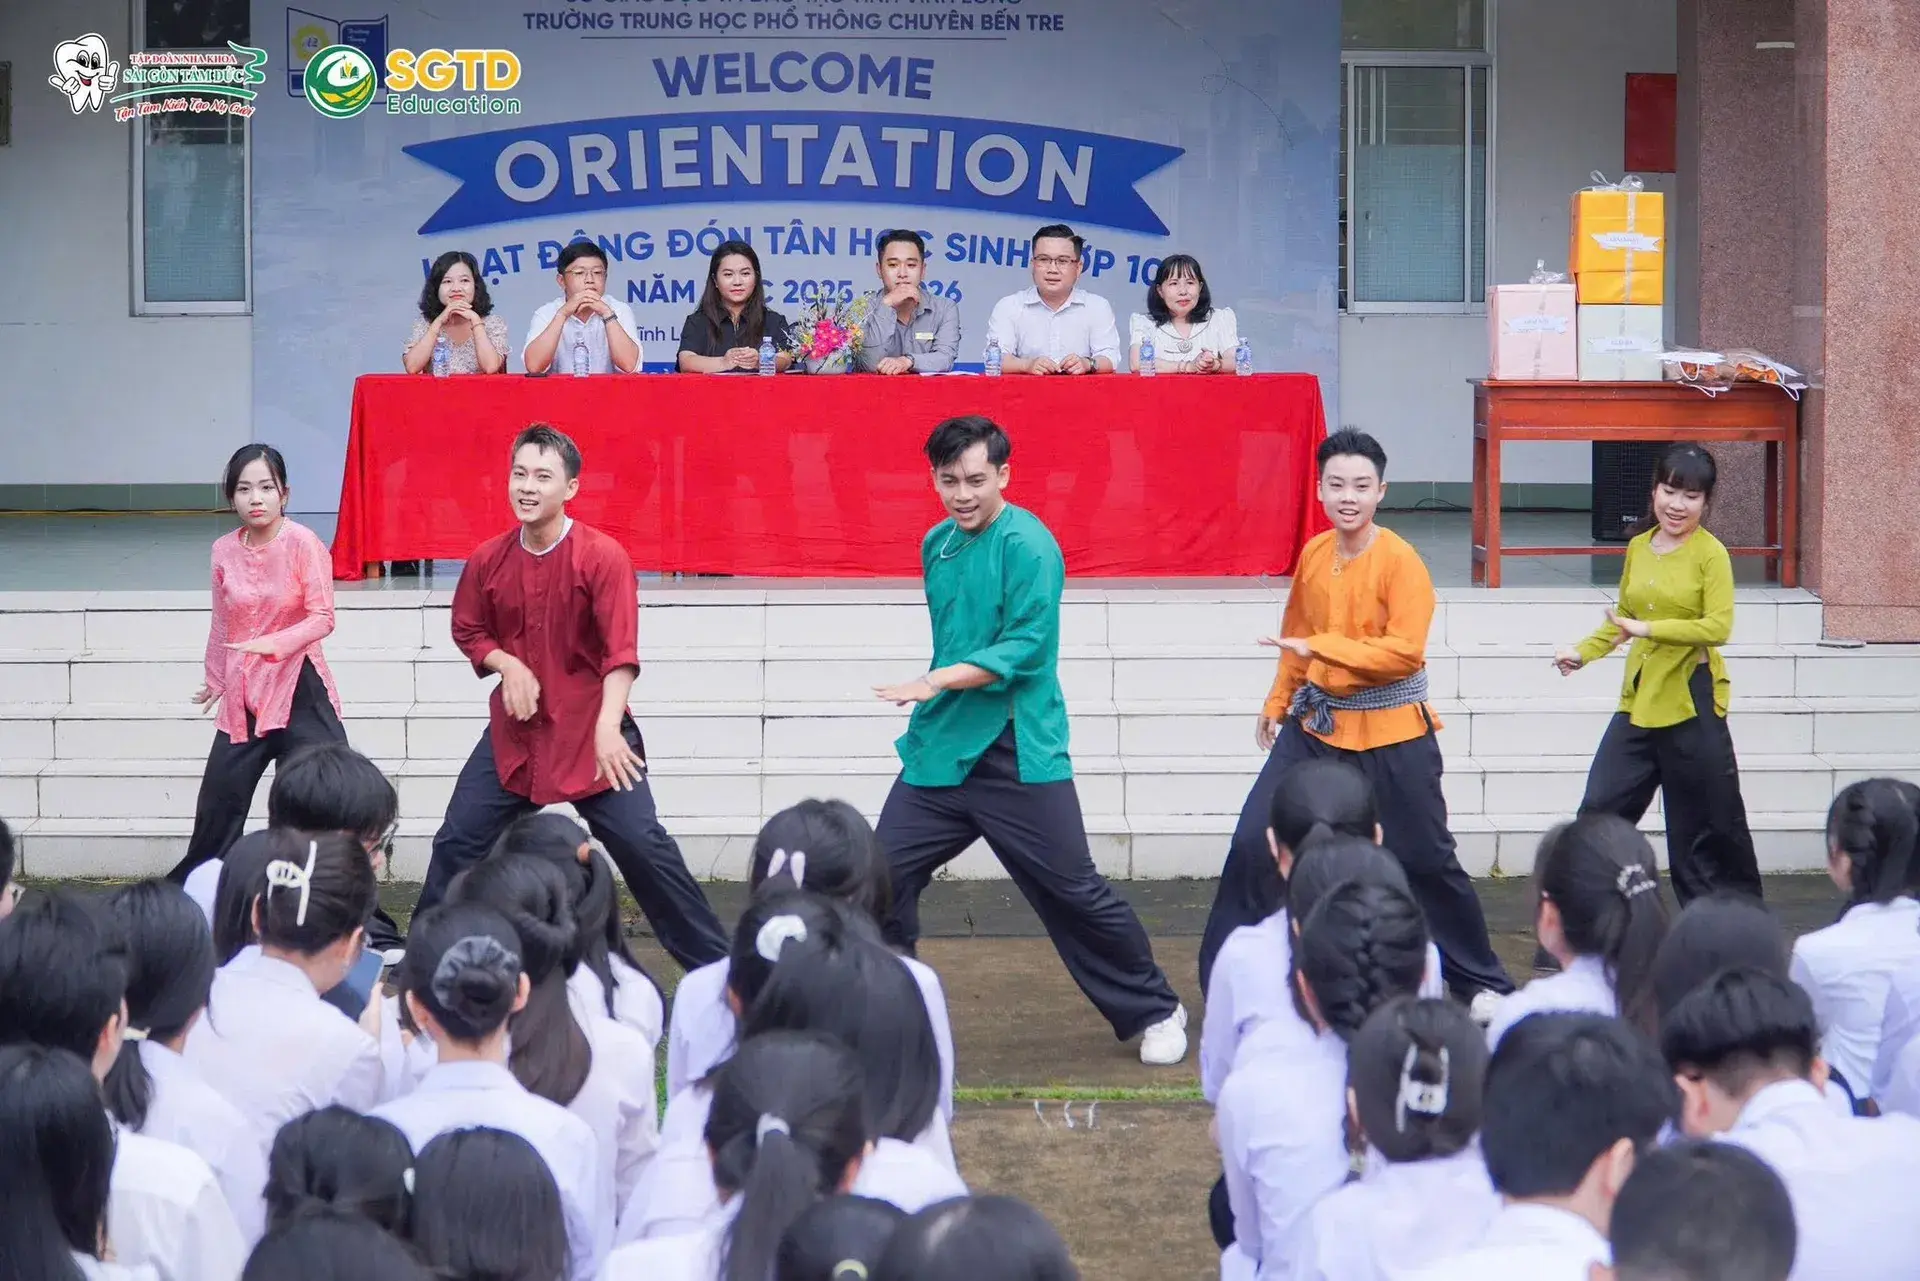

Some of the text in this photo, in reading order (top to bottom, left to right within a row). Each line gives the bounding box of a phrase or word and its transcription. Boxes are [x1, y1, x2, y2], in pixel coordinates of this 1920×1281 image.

[523, 5, 1064, 34] TRƯỜNG TRUNG HỌC PHỔ THÔNG CHUYÊN BẾN TRE
[652, 50, 935, 100] WELCOME
[495, 124, 1094, 206] ORIENTATION
[422, 244, 524, 285] ẠT
[537, 229, 655, 270] ĐNG
[763, 219, 836, 255] TÂN
[945, 232, 1031, 269] SINH
[1127, 254, 1163, 287] 10
[628, 273, 695, 303] NĂM
[783, 279, 854, 304] 2025
[637, 326, 666, 341] ĩnh
